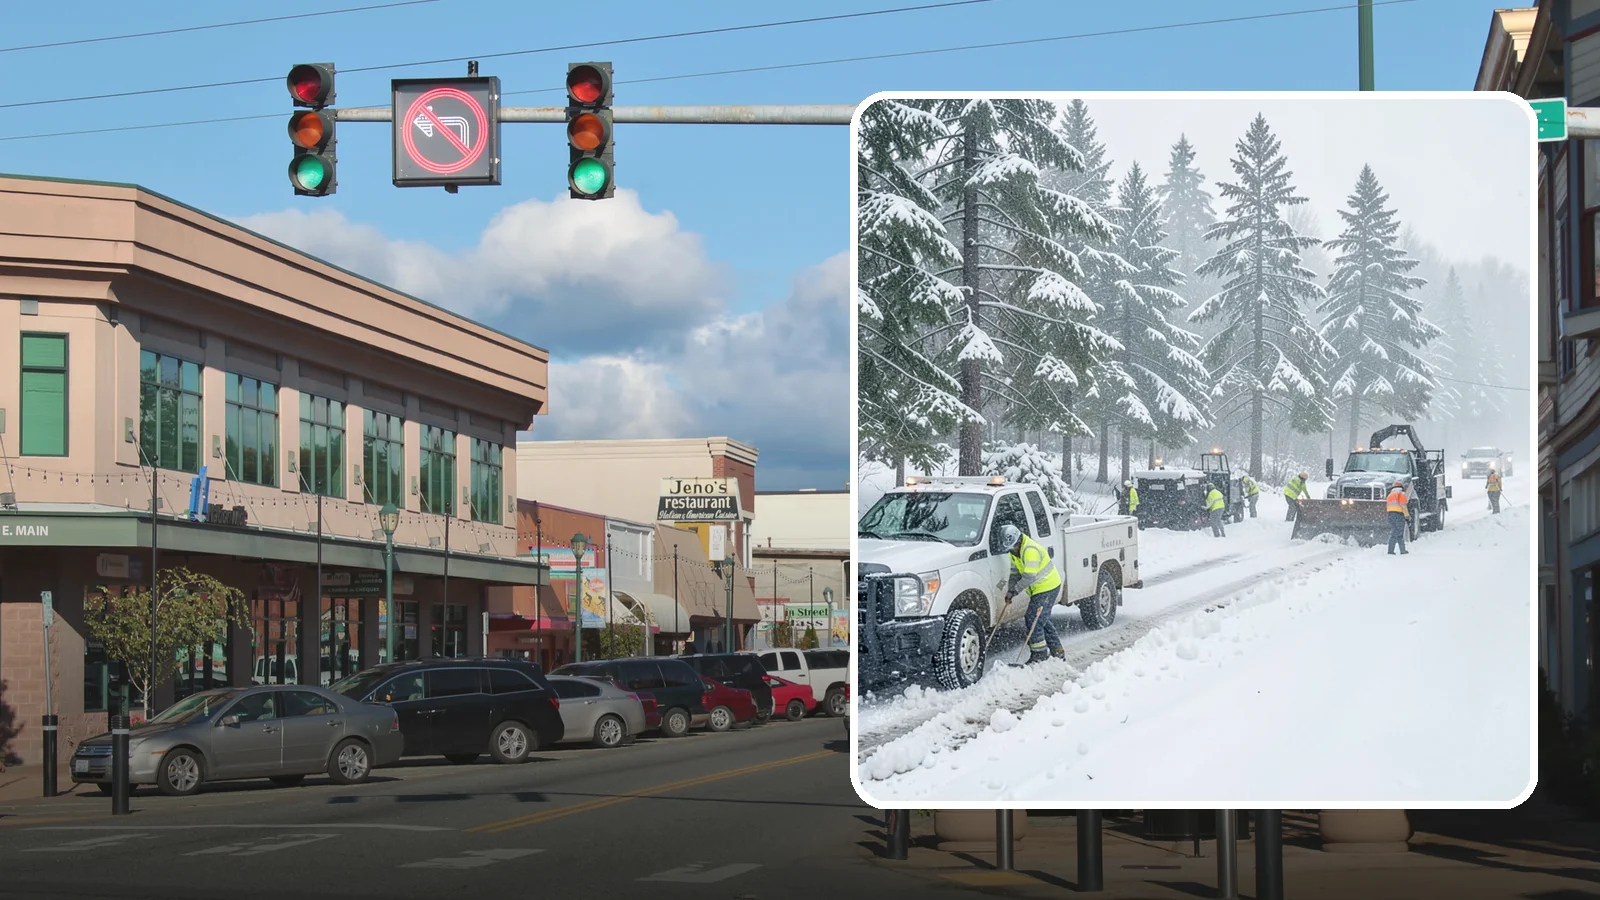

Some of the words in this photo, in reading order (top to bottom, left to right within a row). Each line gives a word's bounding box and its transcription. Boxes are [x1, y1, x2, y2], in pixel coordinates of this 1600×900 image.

[669, 480, 727, 495] Jeno's
[665, 496, 731, 509] restaurant
[658, 510, 682, 520] Italian
[685, 509, 715, 520] American
[714, 509, 738, 520] Cuisine
[2, 525, 13, 536] E.
[15, 525, 49, 536] MAIN
[797, 607, 828, 617] Street
[791, 619, 824, 627] lass
